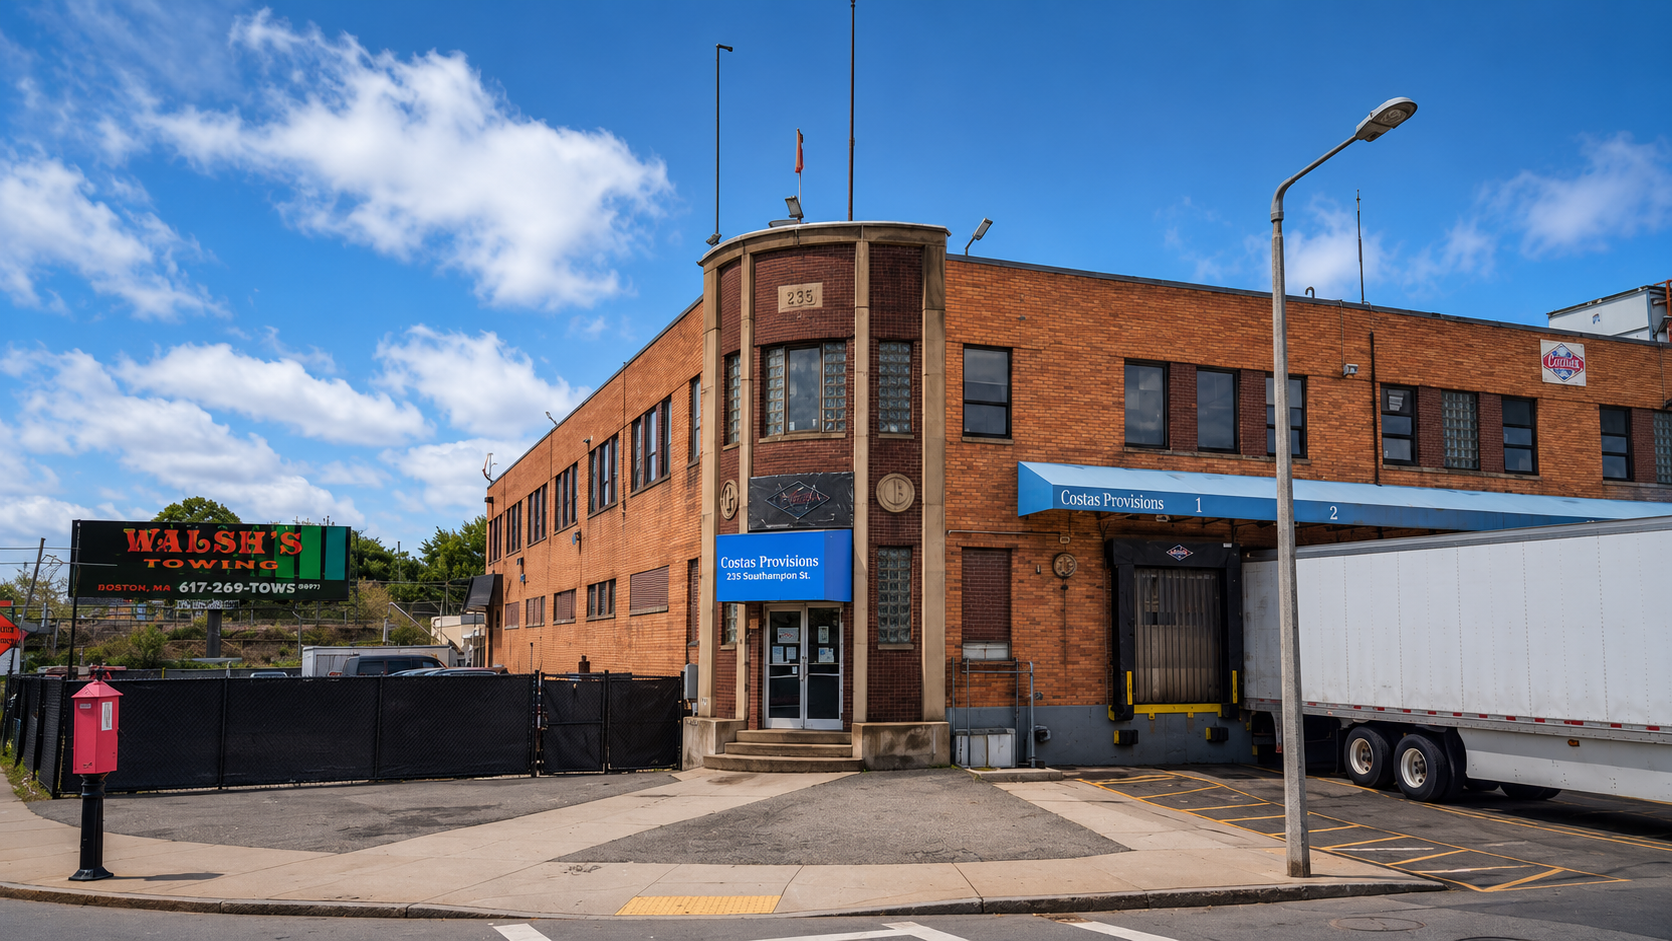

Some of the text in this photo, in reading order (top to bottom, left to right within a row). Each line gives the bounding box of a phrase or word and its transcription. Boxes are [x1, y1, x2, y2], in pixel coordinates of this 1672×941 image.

[786, 289, 813, 305] 235
[1061, 489, 1165, 510] Costas Provisions
[1195, 497, 1203, 513] 1
[1329, 505, 1338, 520] 2
[123, 528, 303, 555] WALSH'S
[143, 558, 279, 570] TOWING
[720, 554, 819, 569] Costas Provisions
[799, 571, 811, 580] St.
[97, 583, 150, 593] BOSTON,
[152, 584, 171, 592] MA
[179, 581, 296, 594] 617-269-TOWS
